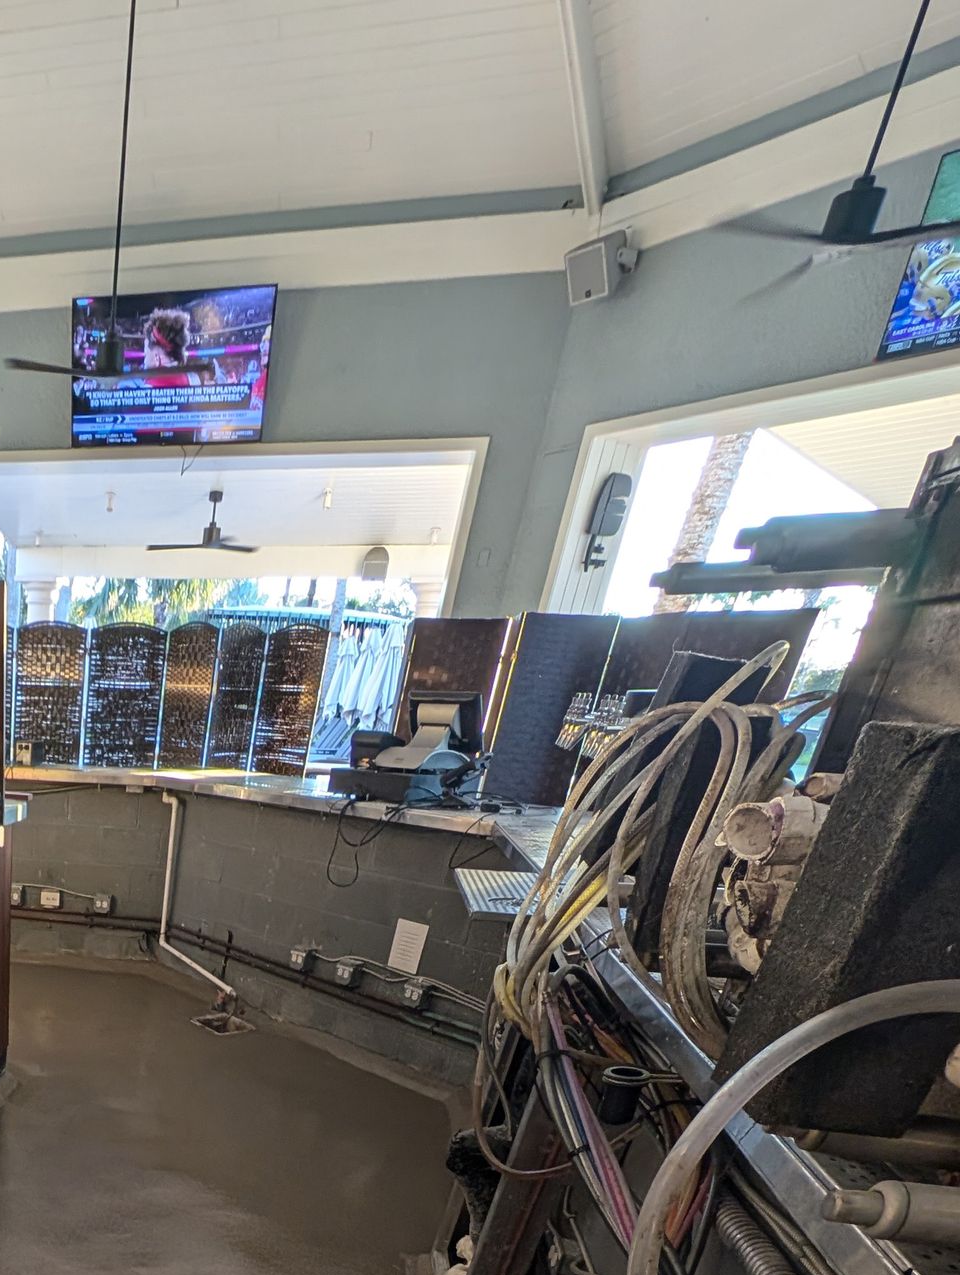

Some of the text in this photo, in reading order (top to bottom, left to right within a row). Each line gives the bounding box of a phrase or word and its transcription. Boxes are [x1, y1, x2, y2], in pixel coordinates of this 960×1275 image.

[92, 391, 112, 400] KNOW
[124, 389, 151, 398] HAVEN'T
[151, 388, 175, 397] BEATEN
[176, 387, 194, 396] THEM
[194, 387, 203, 395] IN
[203, 386, 215, 395] THE
[90, 399, 99, 408] SO
[99, 398, 122, 407] THAT'S
[122, 398, 134, 406] THE
[134, 397, 151, 405] ONLY
[152, 396, 171, 404] THING
[172, 396, 188, 404] THAT
[189, 395, 210, 403] KINDA
